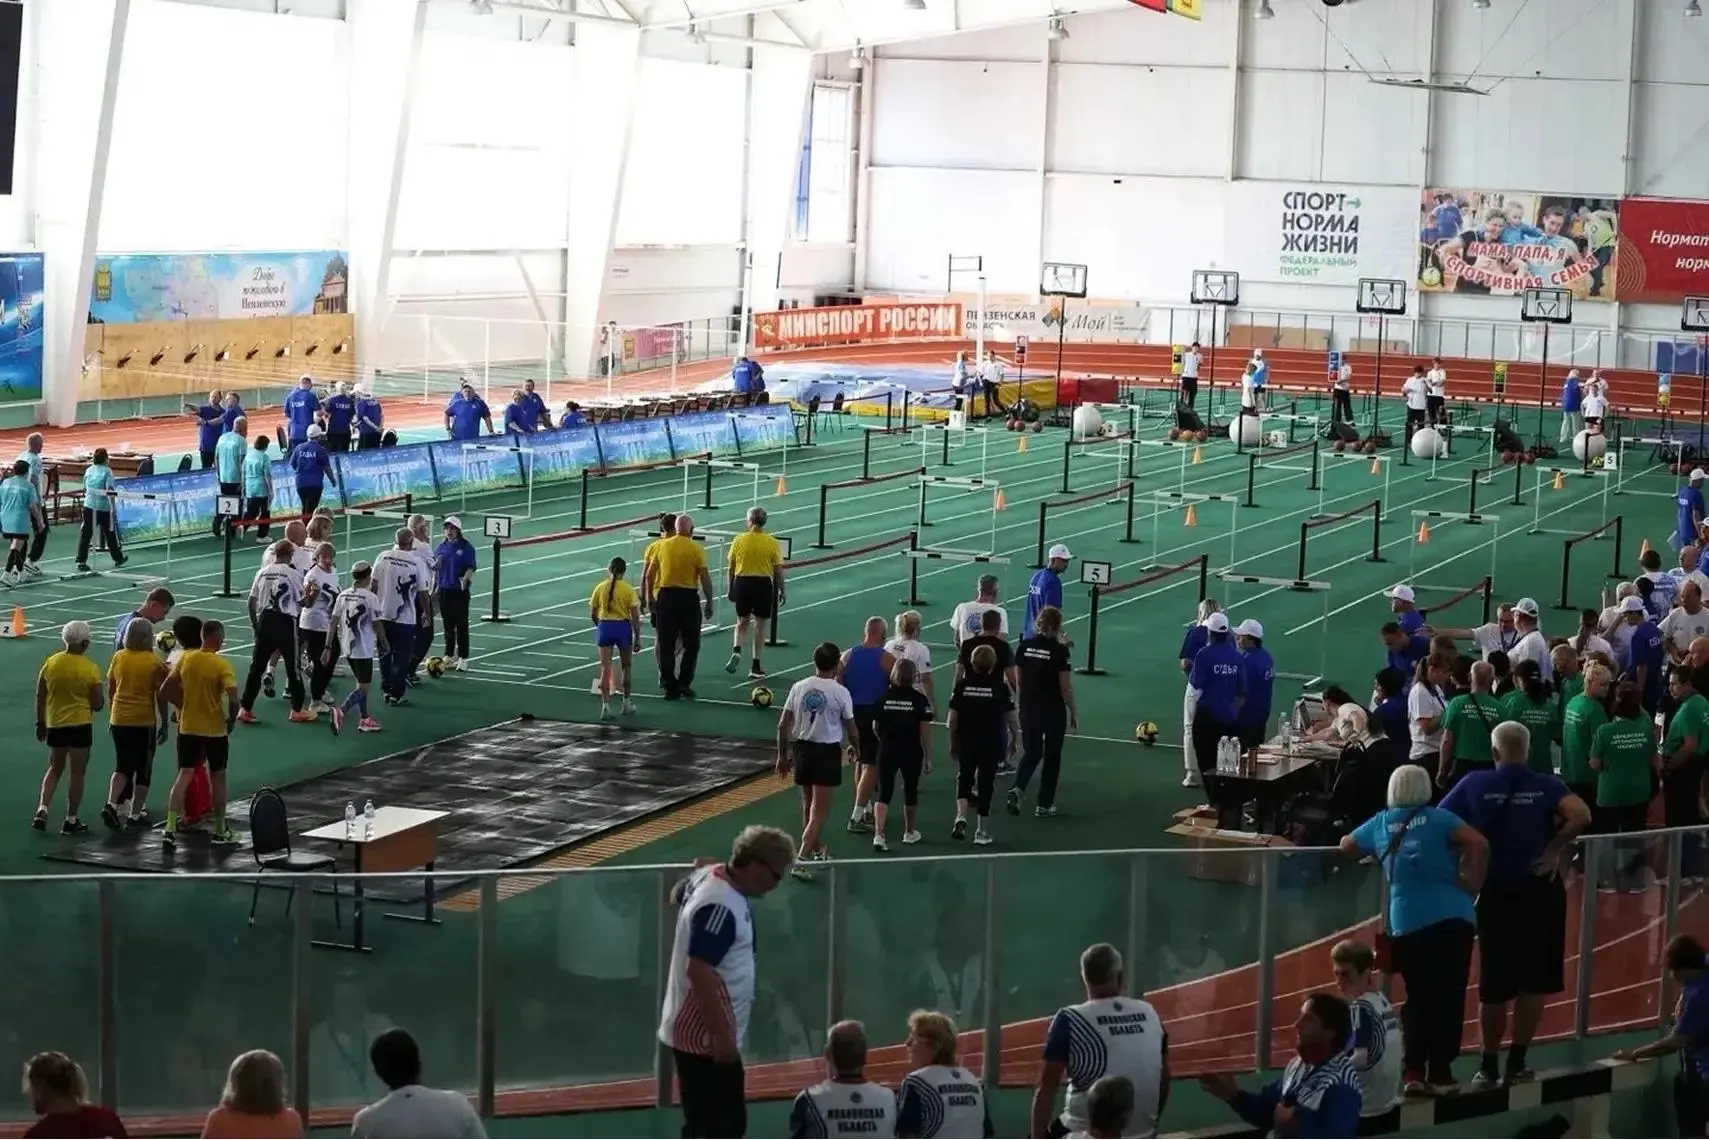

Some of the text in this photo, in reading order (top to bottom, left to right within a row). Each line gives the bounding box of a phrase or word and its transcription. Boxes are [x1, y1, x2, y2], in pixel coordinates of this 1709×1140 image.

[1283, 192, 1347, 211] СПОРТ
[1282, 212, 1359, 233] НОРМА
[1281, 233, 1358, 254] ЖИЗНИ
[1467, 243, 1567, 262] МАМА, ПАПА, Я
[1280, 256, 1357, 267] ФЕДЕРАЛЬНЫЙ
[1280, 267, 1320, 276] ПРОЕКТ
[1446, 254, 1599, 290] СПОРТИВНАЯ СЕМЬЯ
[778, 305, 956, 339] МИНСПОРТ РОССИИ
[1071, 314, 1107, 331] Мой
[1607, 456, 1613, 464] 5
[224, 500, 232, 513] 2
[493, 521, 501, 535] 3
[1091, 567, 1100, 581] 5
[3, 626, 9, 634] 2
